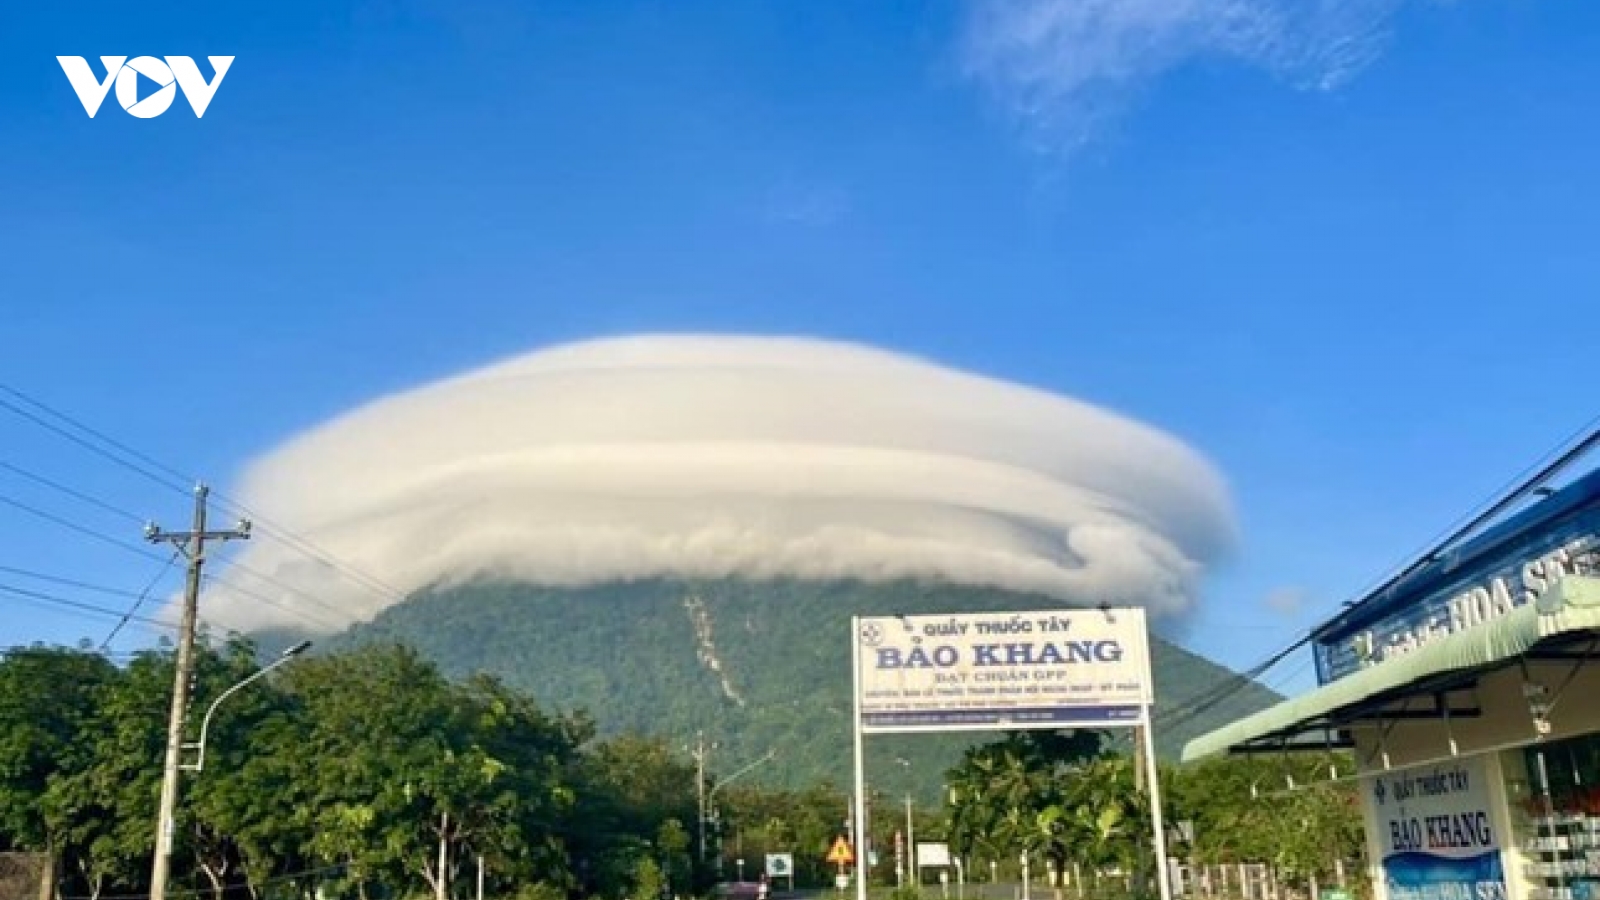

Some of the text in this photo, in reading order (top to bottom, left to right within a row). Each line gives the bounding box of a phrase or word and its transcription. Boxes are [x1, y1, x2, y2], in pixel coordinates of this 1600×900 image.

[975, 615, 1032, 634] THUỐC
[1037, 615, 1071, 632] TÂY
[876, 636, 1122, 669] BẢO KHANG
[1424, 811, 1491, 849] KHANG
